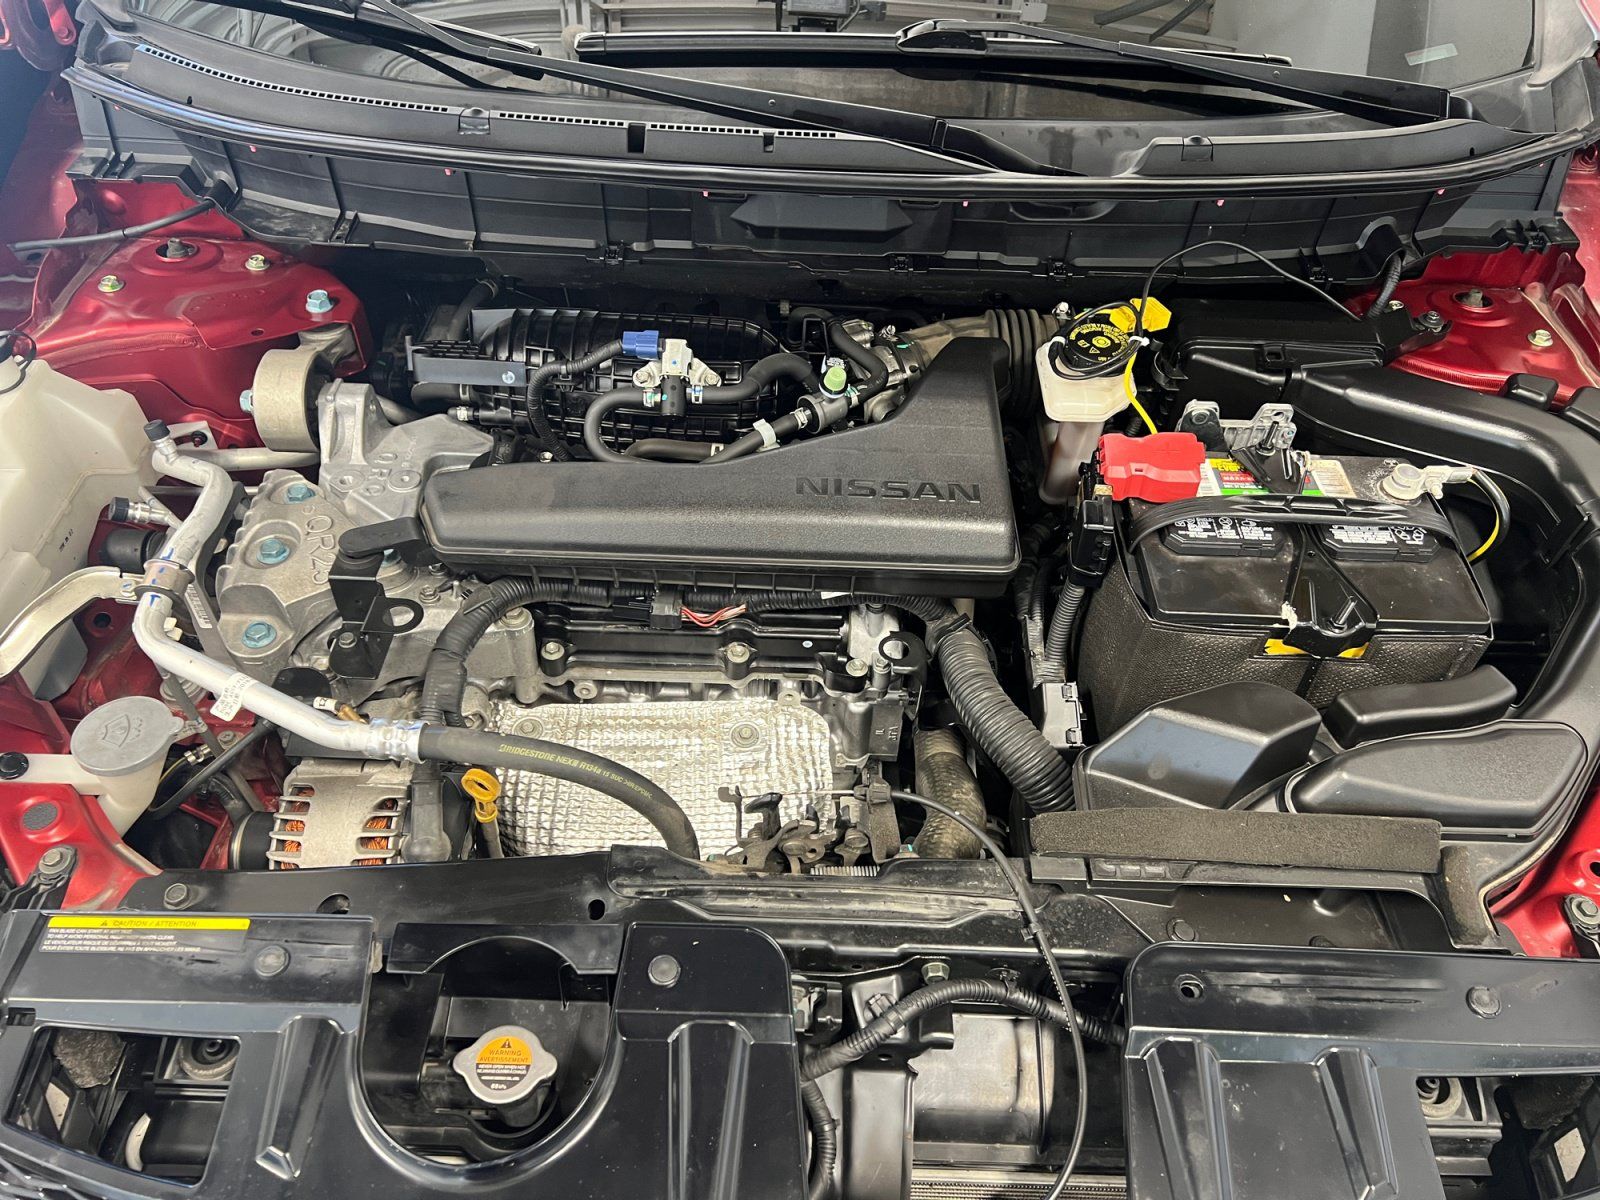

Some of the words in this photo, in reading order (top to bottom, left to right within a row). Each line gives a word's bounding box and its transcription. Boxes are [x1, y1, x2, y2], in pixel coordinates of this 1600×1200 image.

[796, 477, 981, 503] NISSAN
[305, 515, 337, 585] QR25
[498, 744, 556, 762] BRIDGESTONE
